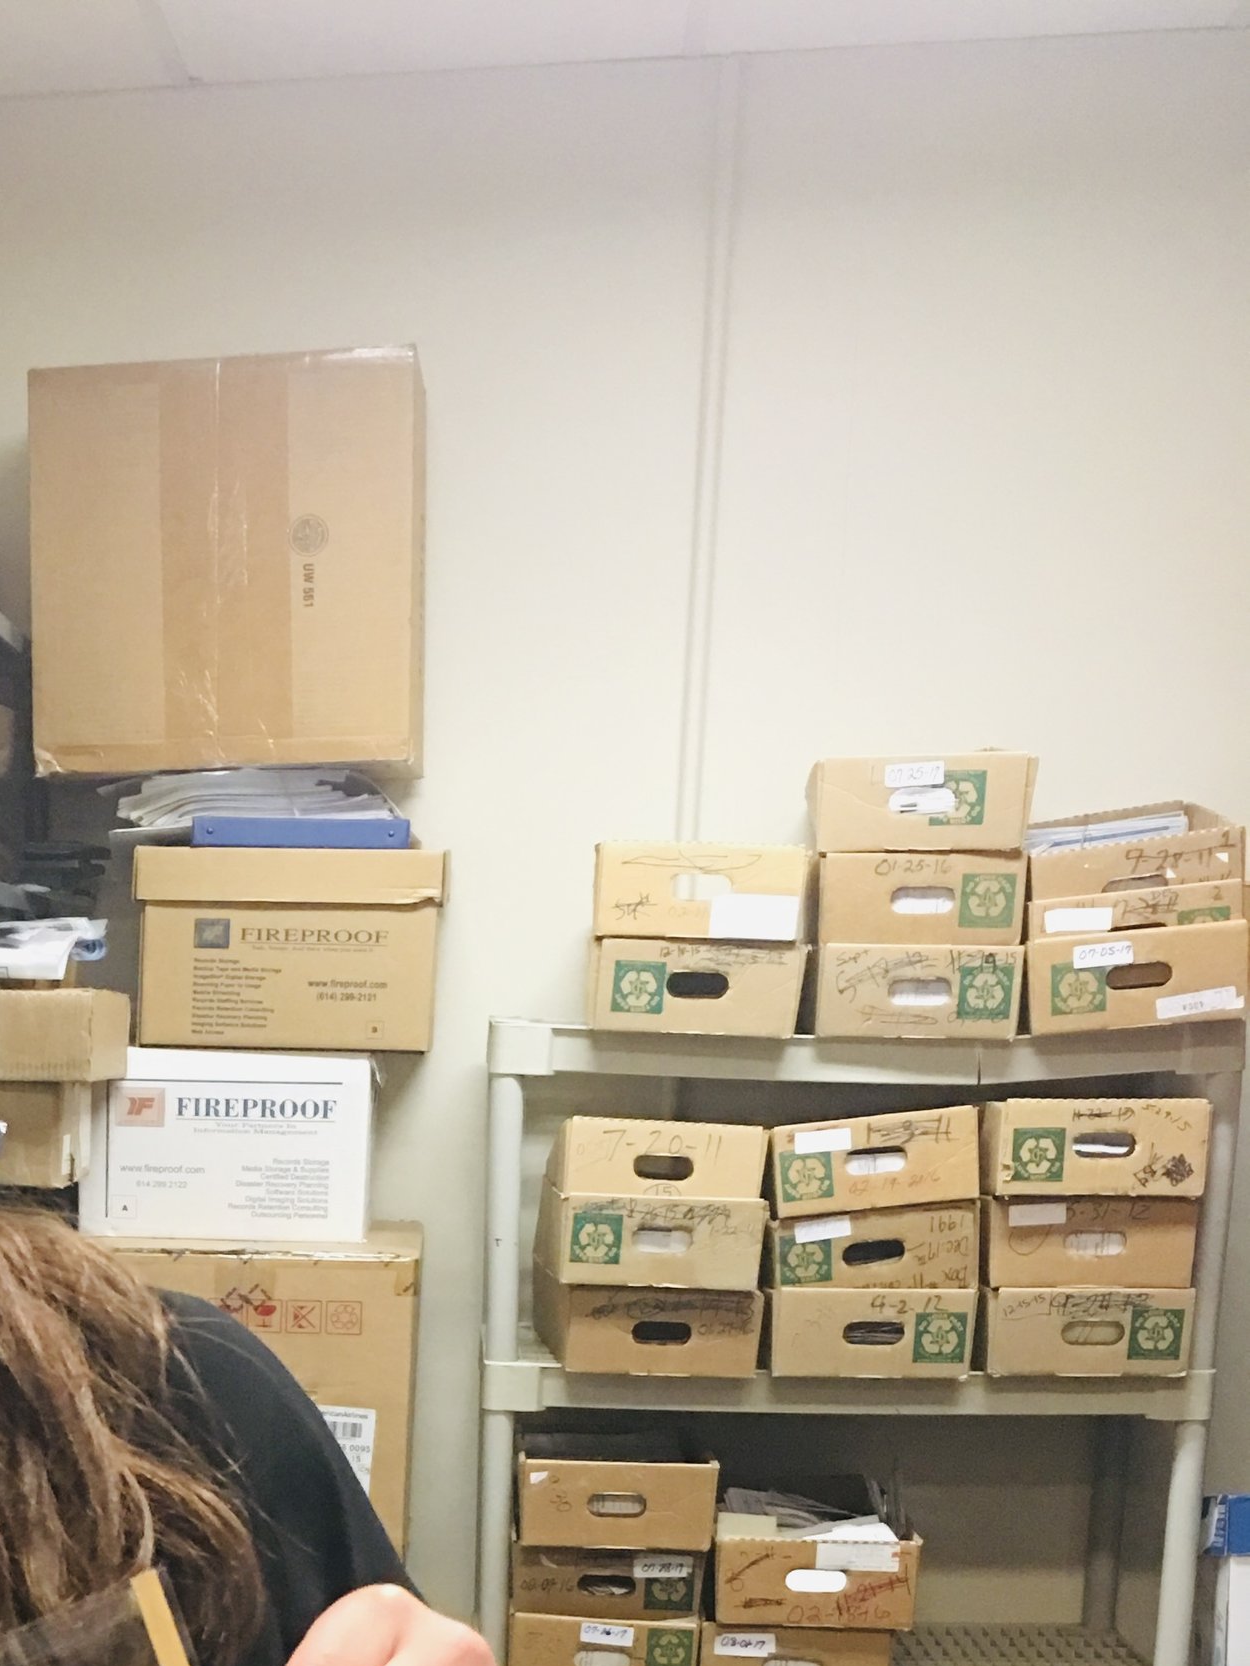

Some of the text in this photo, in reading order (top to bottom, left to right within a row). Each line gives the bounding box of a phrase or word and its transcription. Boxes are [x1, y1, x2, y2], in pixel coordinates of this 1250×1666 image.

[240, 927, 390, 944] FIREPROOF
[307, 979, 388, 989] www.fireproof.com
[176, 1097, 338, 1120] FIREPROOF
[119, 1164, 206, 1174] www.fireproof.com
[121, 1204, 129, 1212] A
